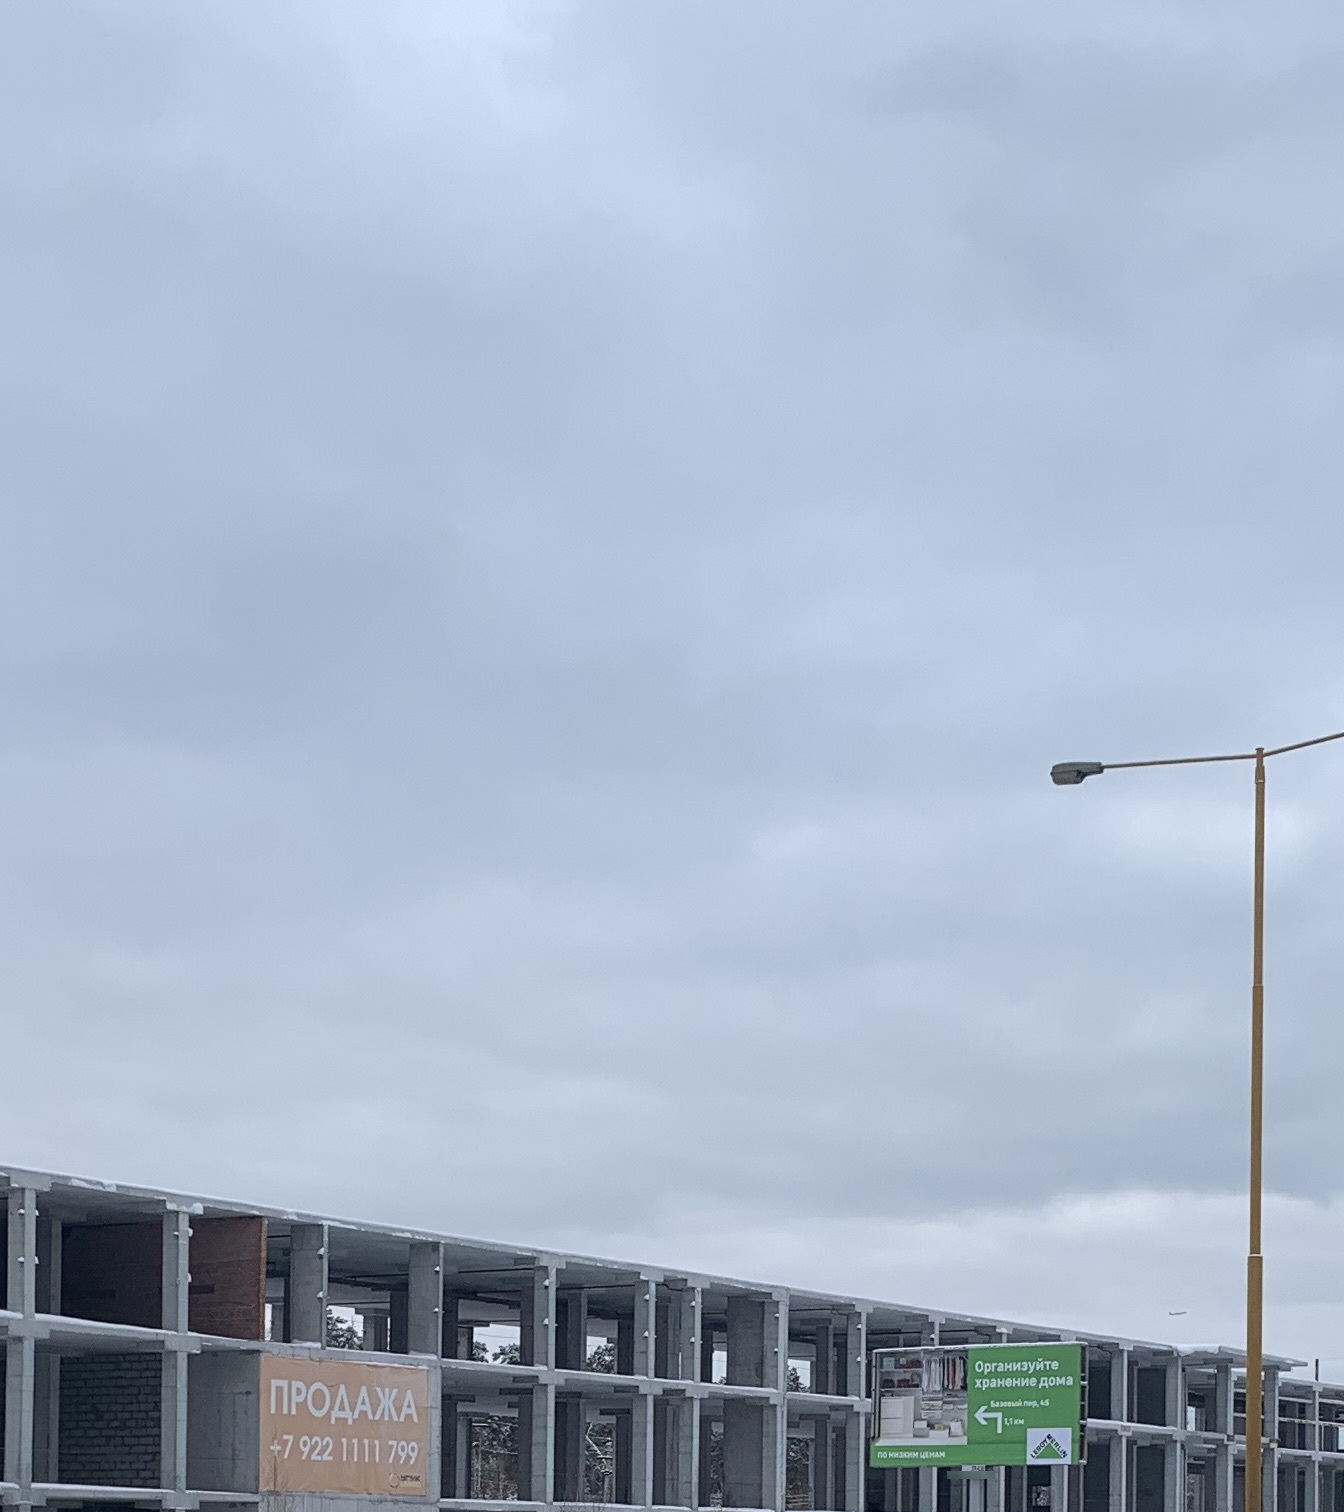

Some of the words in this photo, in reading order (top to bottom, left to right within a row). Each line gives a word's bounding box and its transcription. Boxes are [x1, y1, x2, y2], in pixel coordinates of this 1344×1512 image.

[975, 1359, 1059, 1375] Организуйте
[975, 1377, 1037, 1390] хранение
[1039, 1376, 1073, 1388] дома
[270, 1379, 418, 1424] ПРОДАЖА
[270, 1435, 293, 1459] +7
[300, 1436, 333, 1461] 922
[388, 1440, 418, 1464] 799
[888, 1451, 919, 1459] НИЗКИМ
[919, 1451, 945, 1459] ЦЕНАМ
[1030, 1437, 1048, 1459] LEROY
[1046, 1433, 1068, 1458] MERLIN
